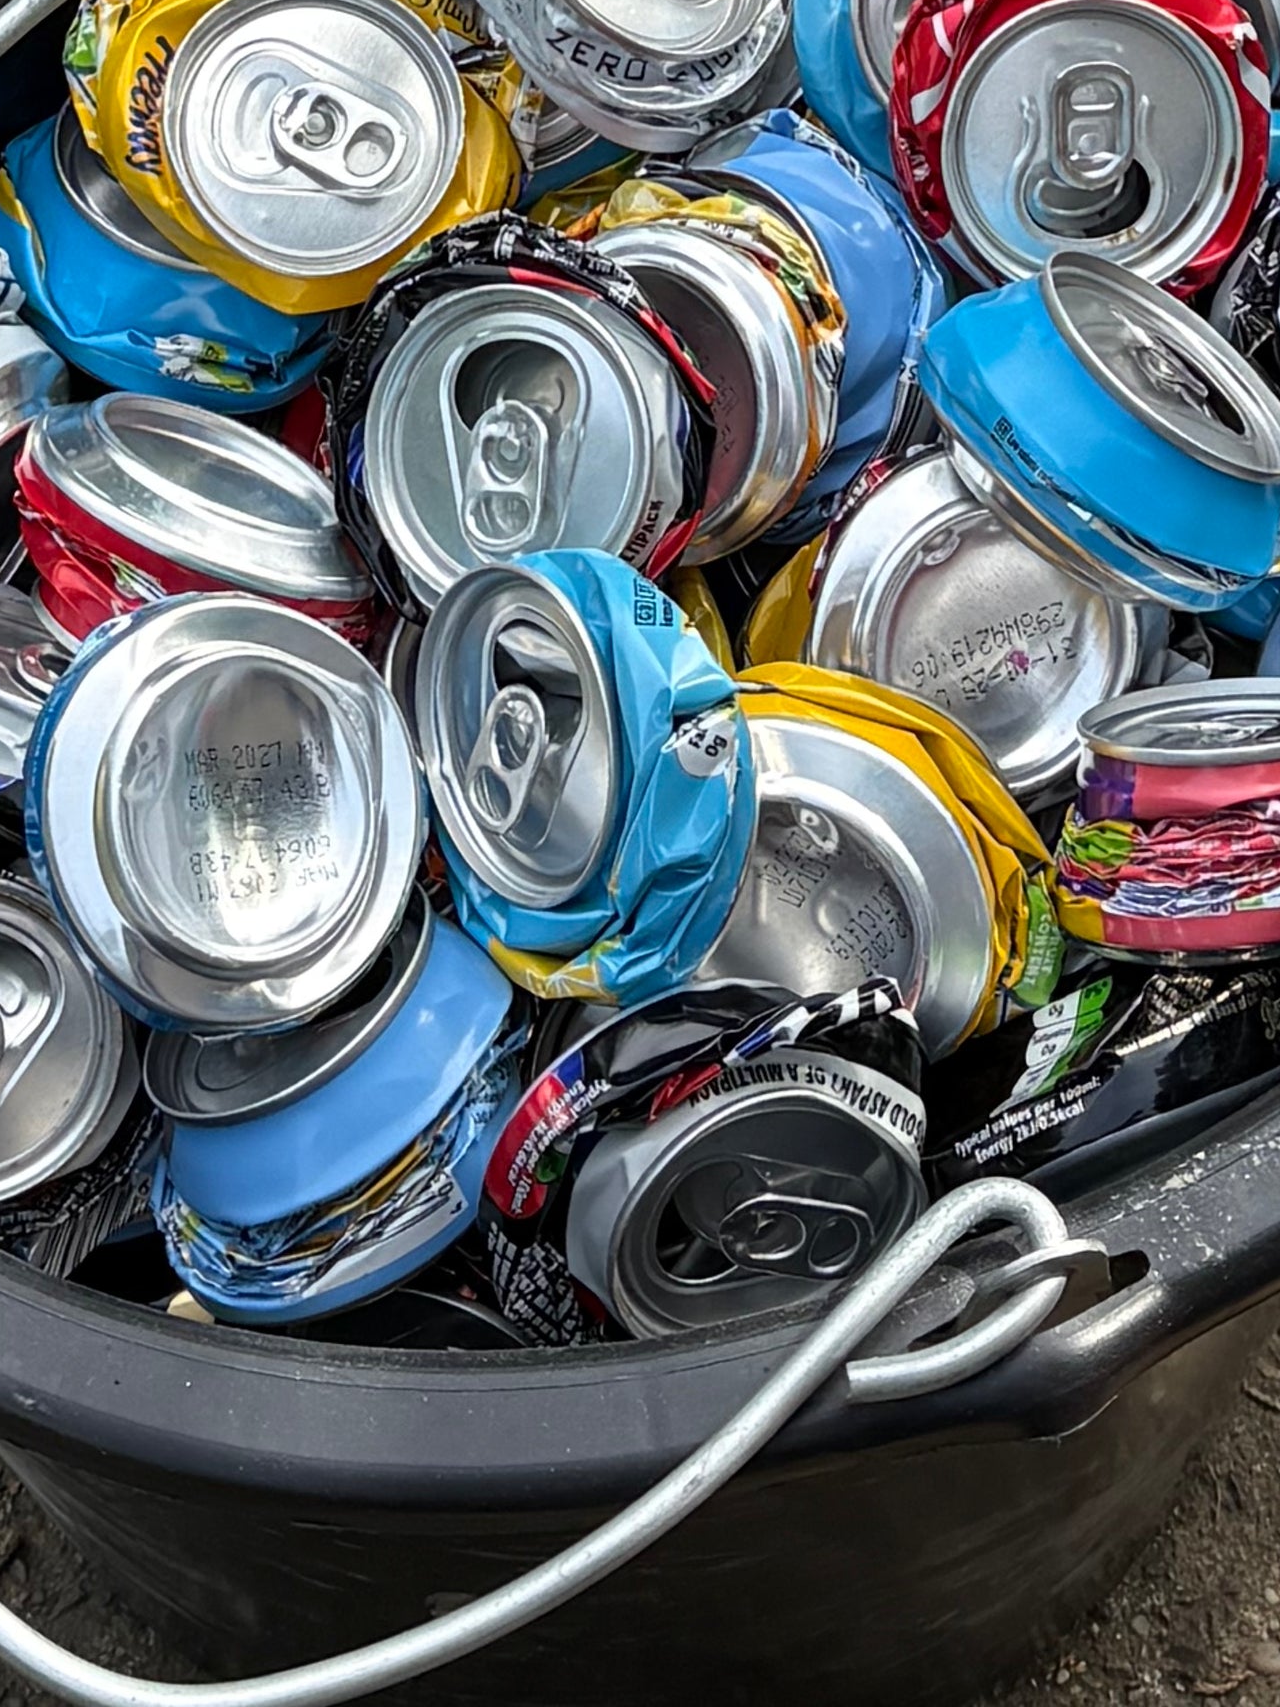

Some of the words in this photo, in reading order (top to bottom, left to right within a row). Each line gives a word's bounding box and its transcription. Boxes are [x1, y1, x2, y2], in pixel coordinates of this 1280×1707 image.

[545, 27, 649, 82] ZERO
[231, 740, 283, 771] 2027
[688, 1062, 785, 1108] MULTIPACK
[786, 1063, 799, 1082] A
[806, 1065, 827, 1085] OF
[991, 1107, 1033, 1135] values
[1033, 1098, 1056, 1118] per
[974, 1133, 1014, 1165] Energy
